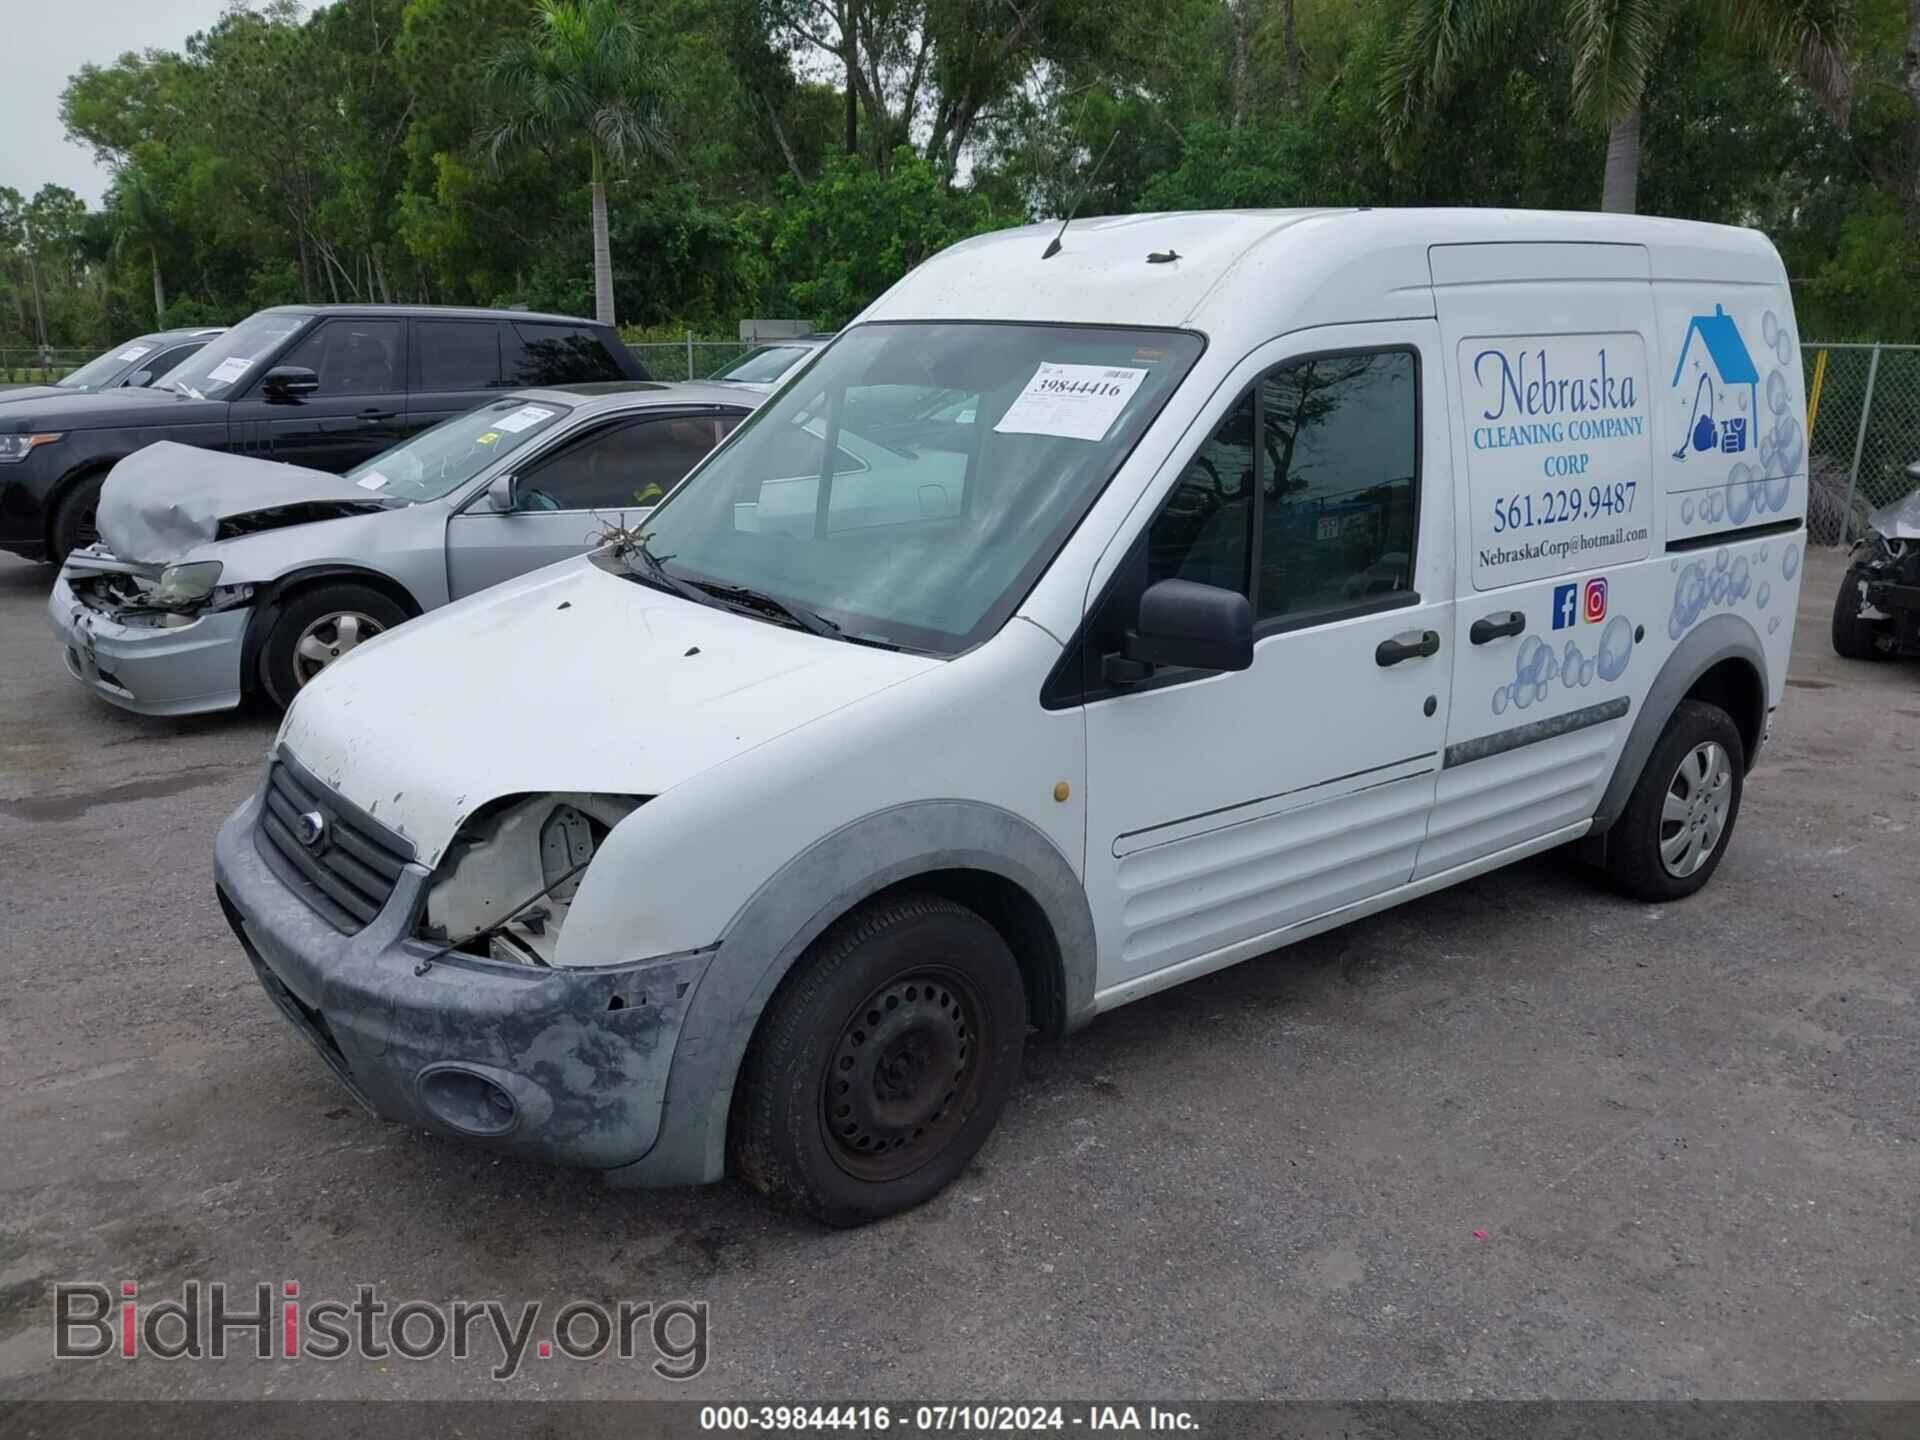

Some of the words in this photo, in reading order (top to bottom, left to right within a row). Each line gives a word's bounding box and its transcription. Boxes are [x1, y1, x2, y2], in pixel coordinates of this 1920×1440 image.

[1034, 379, 1121, 397] 39844416
[1474, 348, 1637, 420] Nebraska
[1474, 422, 1563, 449] CLEANING
[1568, 416, 1644, 441] COMPANY
[1544, 453, 1589, 478] CORP
[1494, 481, 1637, 533] 561.229.9487
[1479, 527, 1648, 568] NebraskaCorp@hotmail.com
